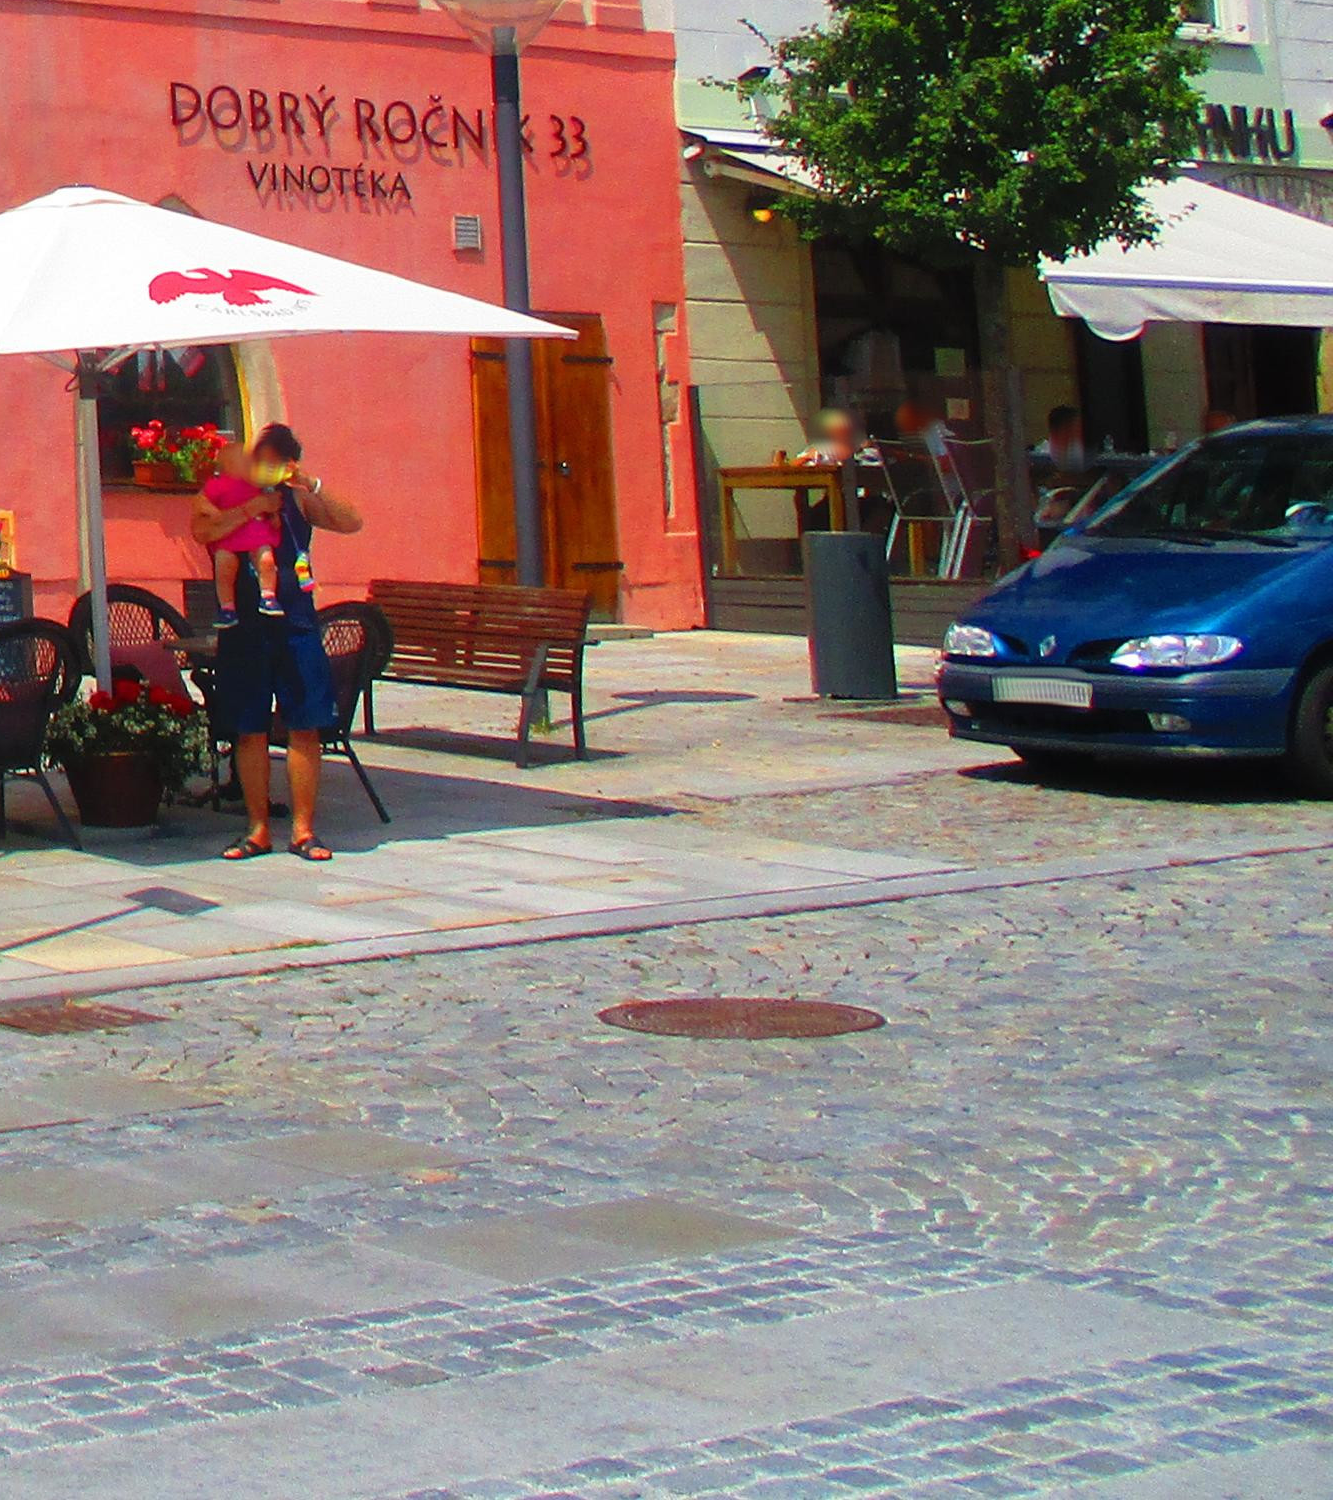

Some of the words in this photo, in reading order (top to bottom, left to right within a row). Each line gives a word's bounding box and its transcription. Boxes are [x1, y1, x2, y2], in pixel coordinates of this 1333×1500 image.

[170, 82, 335, 138] DOBRÝ
[353, 95, 534, 154] ROČNK
[548, 114, 589, 159] 33
[246, 162, 412, 201] VINOTÉKA
